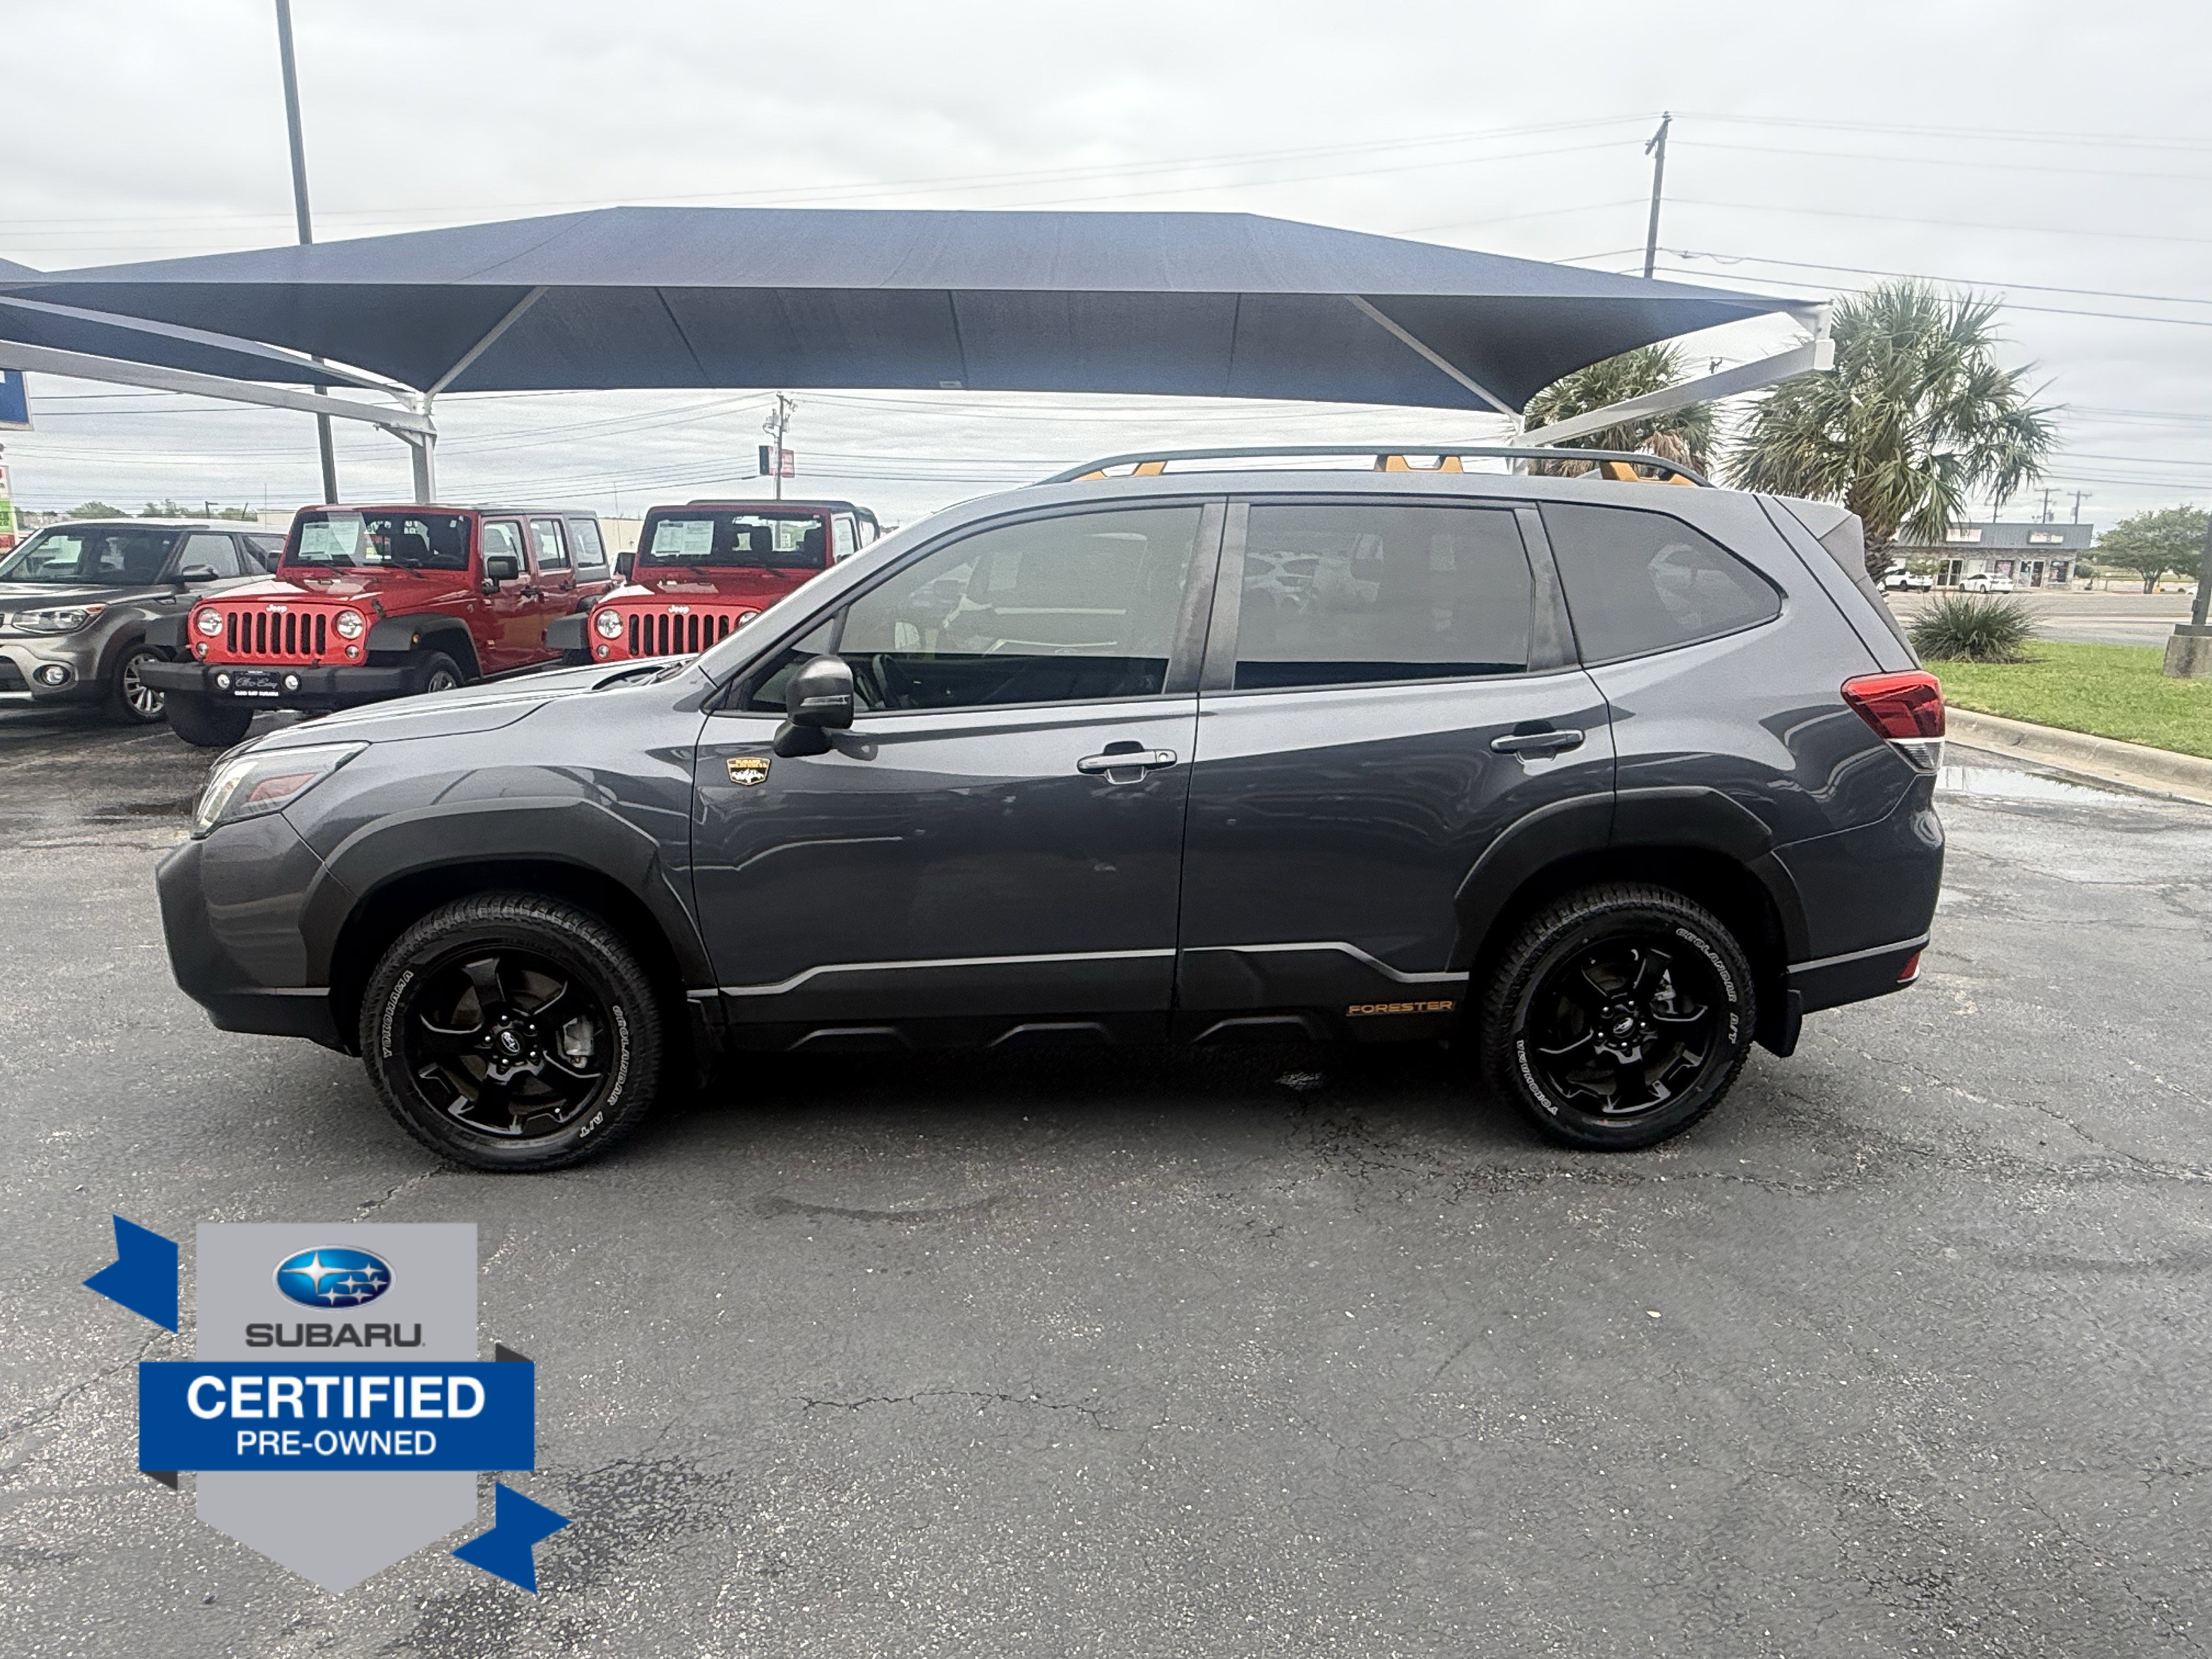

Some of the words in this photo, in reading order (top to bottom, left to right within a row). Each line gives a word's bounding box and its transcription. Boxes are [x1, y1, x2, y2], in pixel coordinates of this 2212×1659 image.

[266, 603, 287, 613] Jeep
[668, 605, 690, 614] Jeep
[1675, 928, 1737, 1003] GEOLANDAR
[382, 969, 415, 1059] YOKOHAMA
[1348, 1000, 1454, 1015] FORESTER
[607, 1005, 630, 1106] GEOLANDAR
